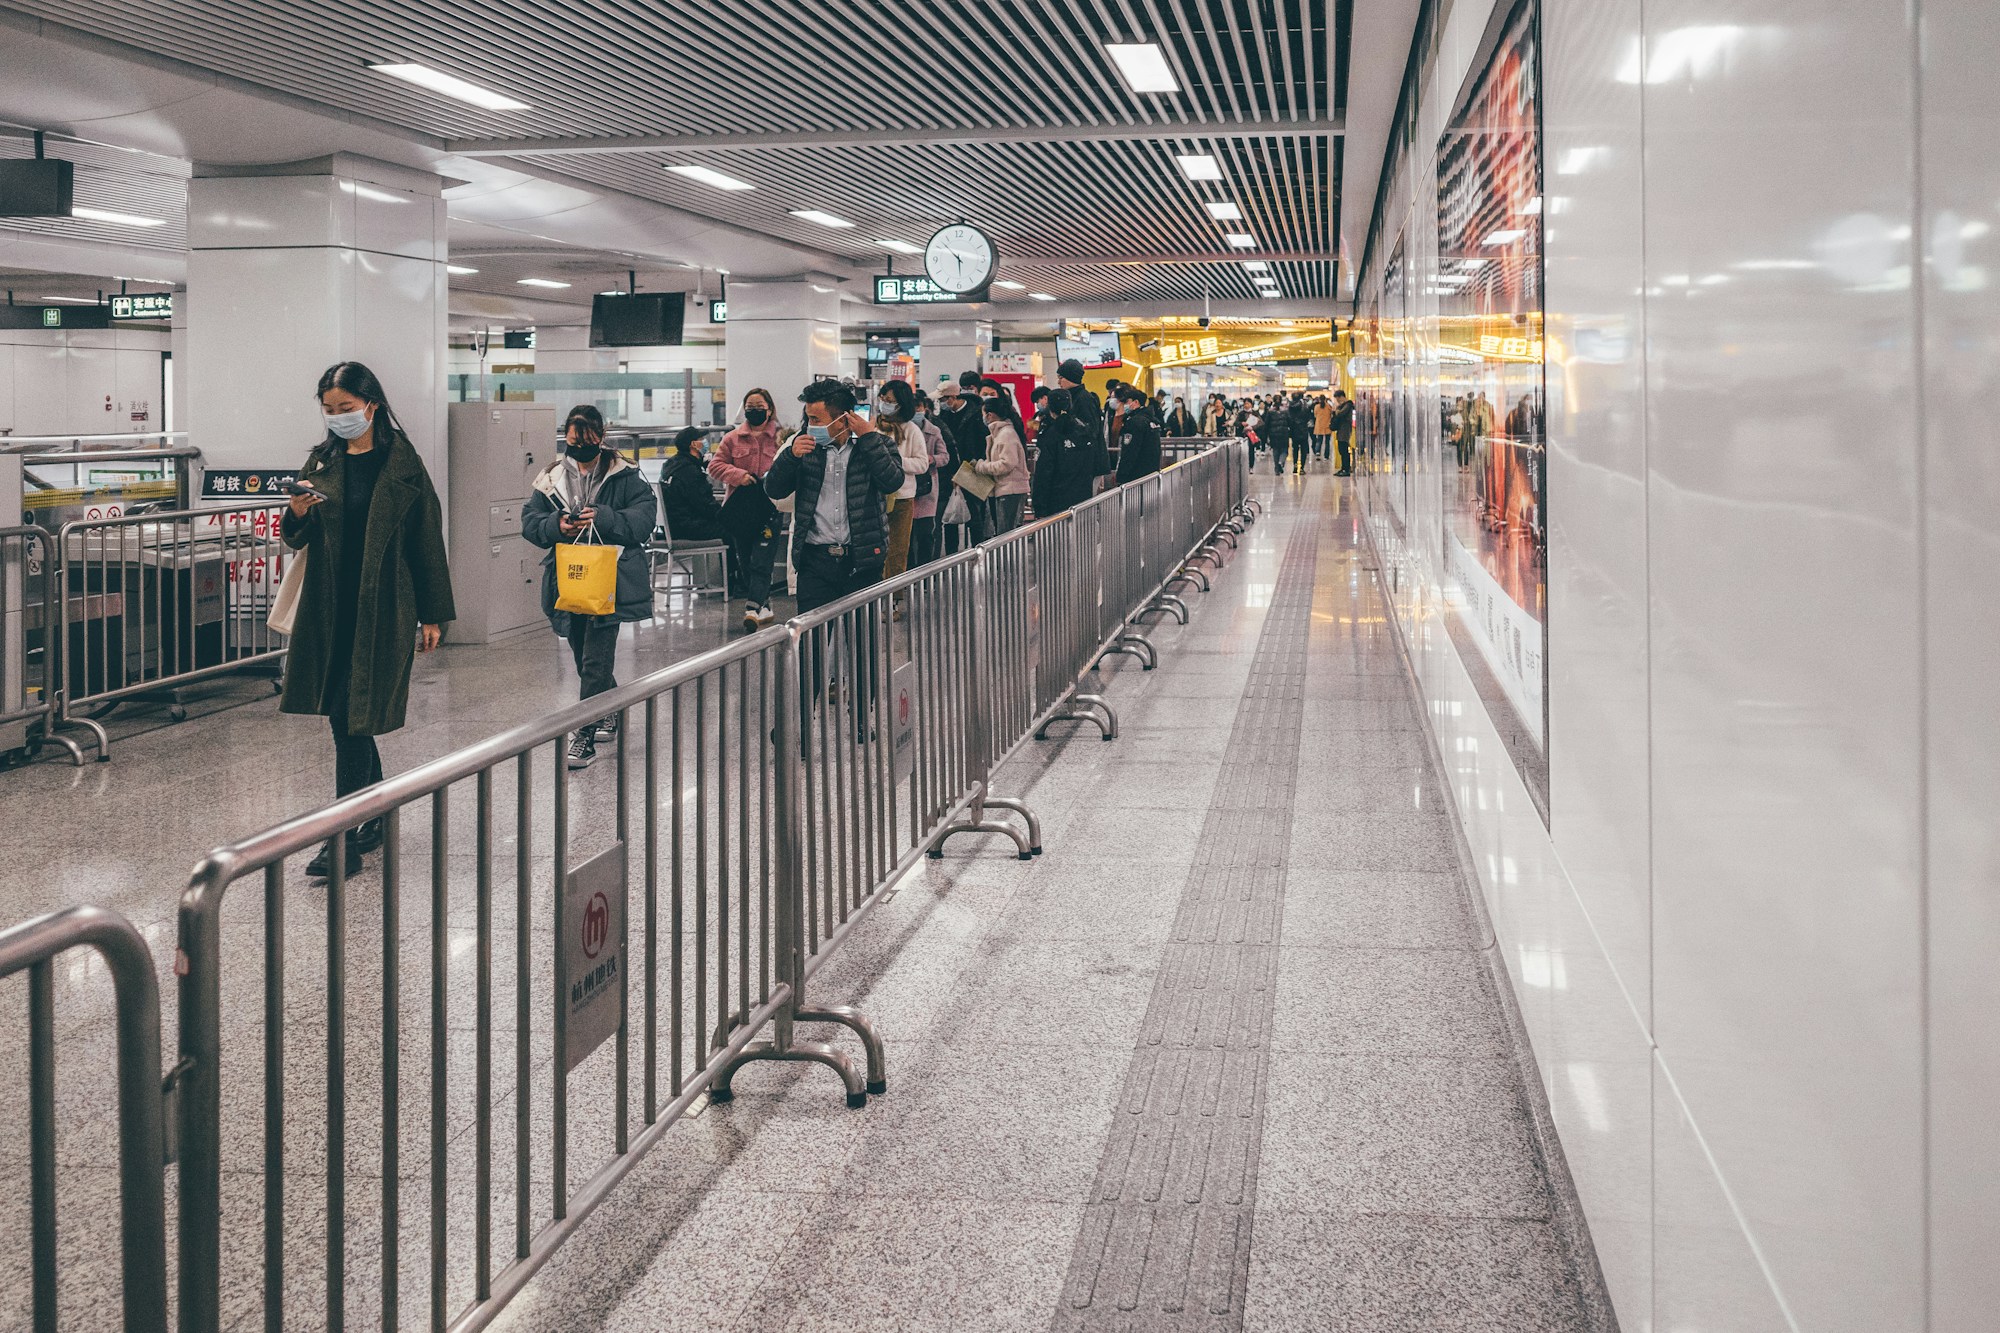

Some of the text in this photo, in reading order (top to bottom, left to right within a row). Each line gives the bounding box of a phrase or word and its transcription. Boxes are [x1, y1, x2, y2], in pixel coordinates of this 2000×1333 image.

[954, 230, 964, 238] 12
[932, 256, 938, 264] 9
[981, 255, 986, 263] 3
[902, 293, 933, 301] Security
[47, 310, 57, 320] 出
[212, 476, 240, 492] 地铁
[571, 955, 617, 1004] 杭州地铁
